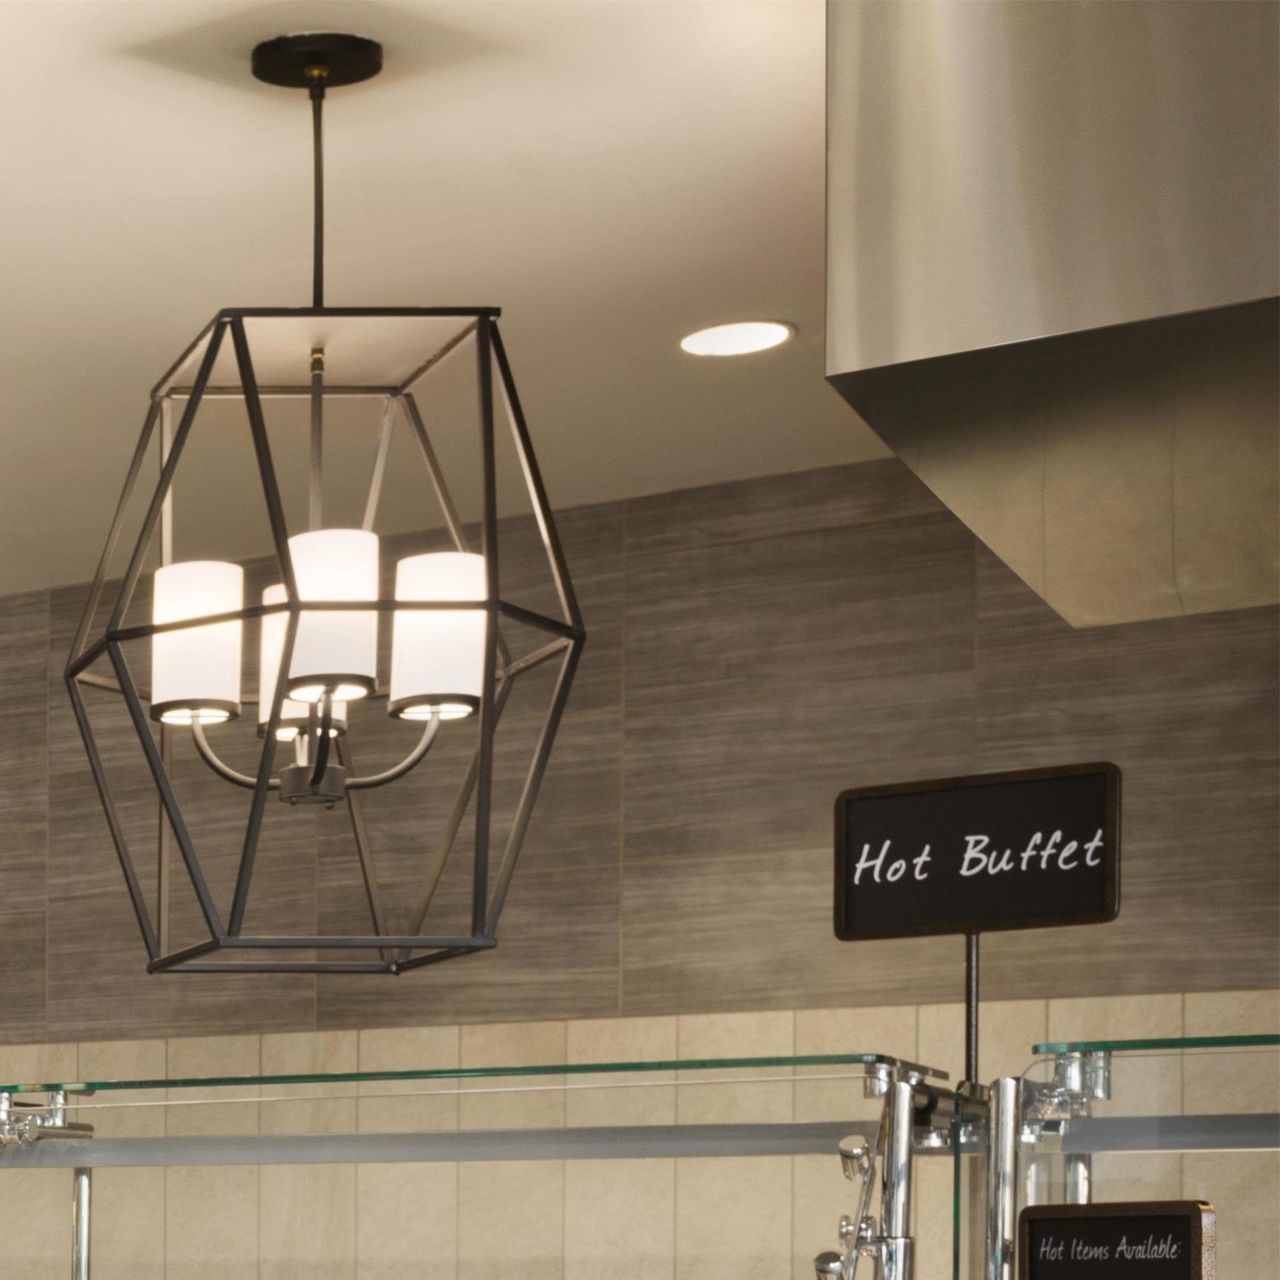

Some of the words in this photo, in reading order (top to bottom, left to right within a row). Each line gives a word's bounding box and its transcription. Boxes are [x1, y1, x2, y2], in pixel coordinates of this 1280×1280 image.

[852, 839, 932, 885] Hot
[958, 828, 1105, 878] Buffet
[1040, 1236, 1065, 1261] Hot
[1071, 1238, 1110, 1261] Items
